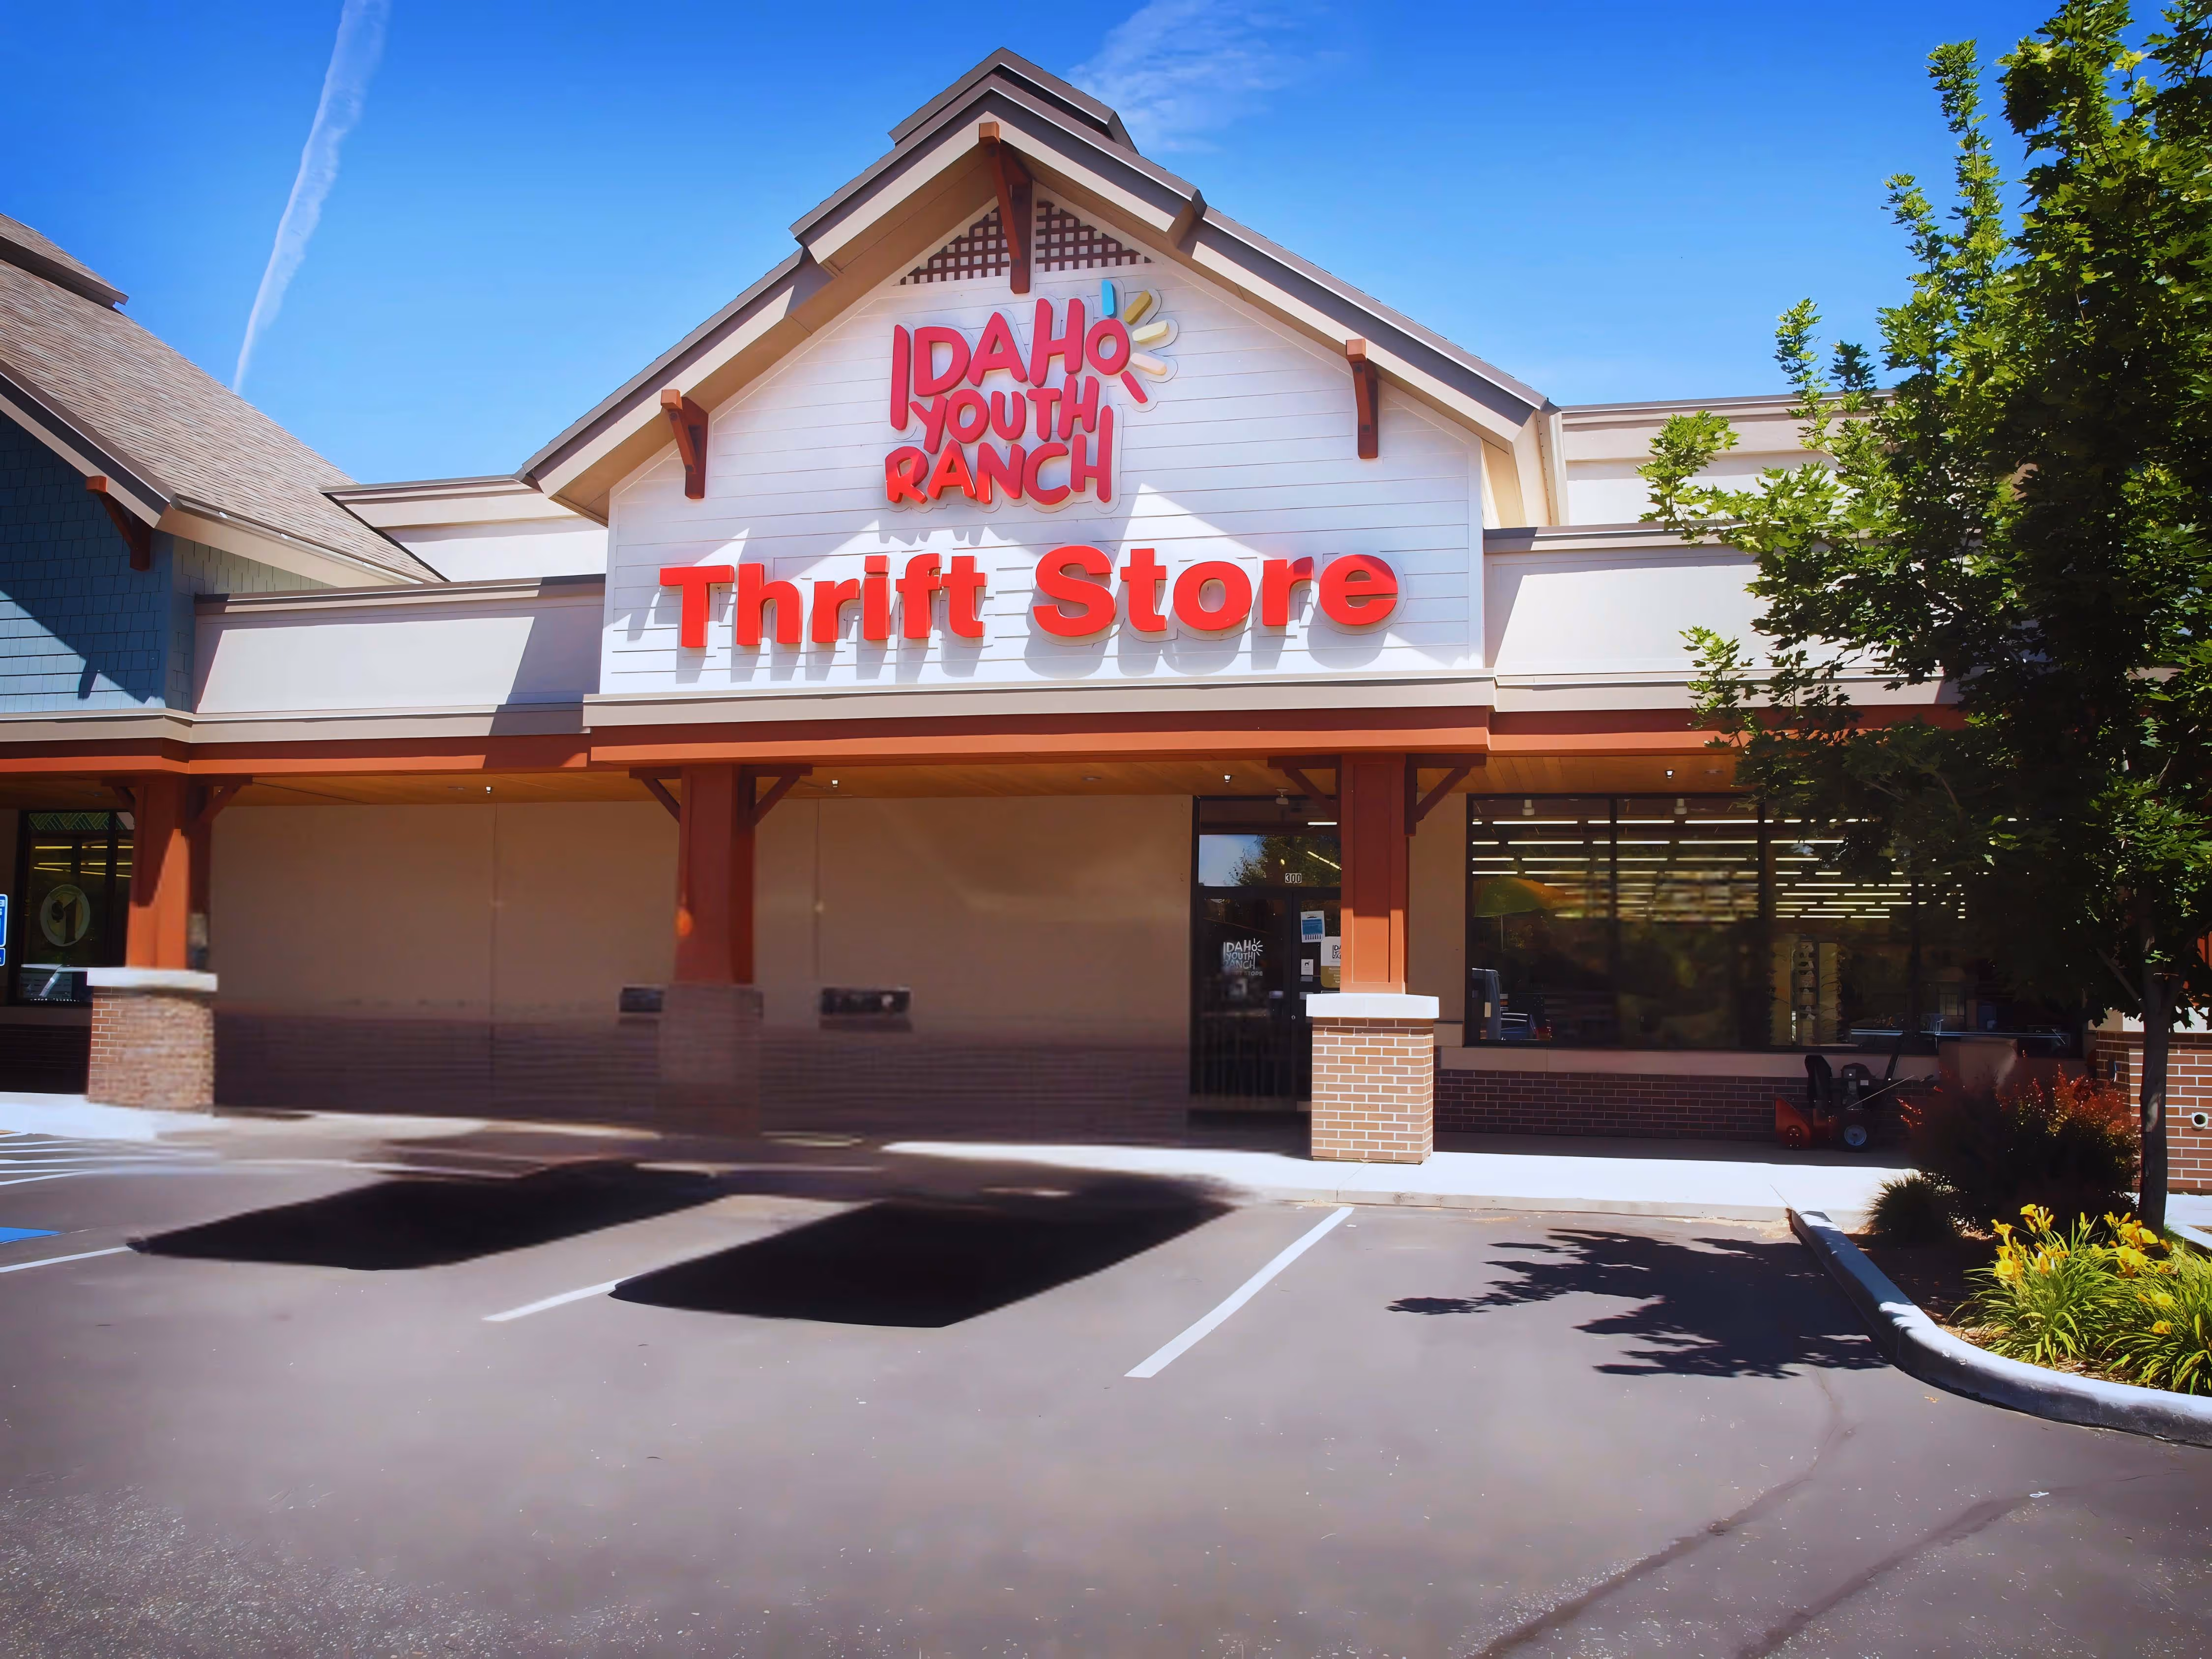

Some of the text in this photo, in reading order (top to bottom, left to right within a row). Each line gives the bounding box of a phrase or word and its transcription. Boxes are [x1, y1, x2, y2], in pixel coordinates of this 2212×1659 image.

[890, 298, 1131, 431] IDAHO
[885, 405, 1113, 505] RANCH
[909, 374, 1099, 454] YOUTH
[659, 545, 1399, 647] Thrift Store
[1223, 939, 1257, 960] IDAHO
[1226, 951, 1253, 960] YOUTH
